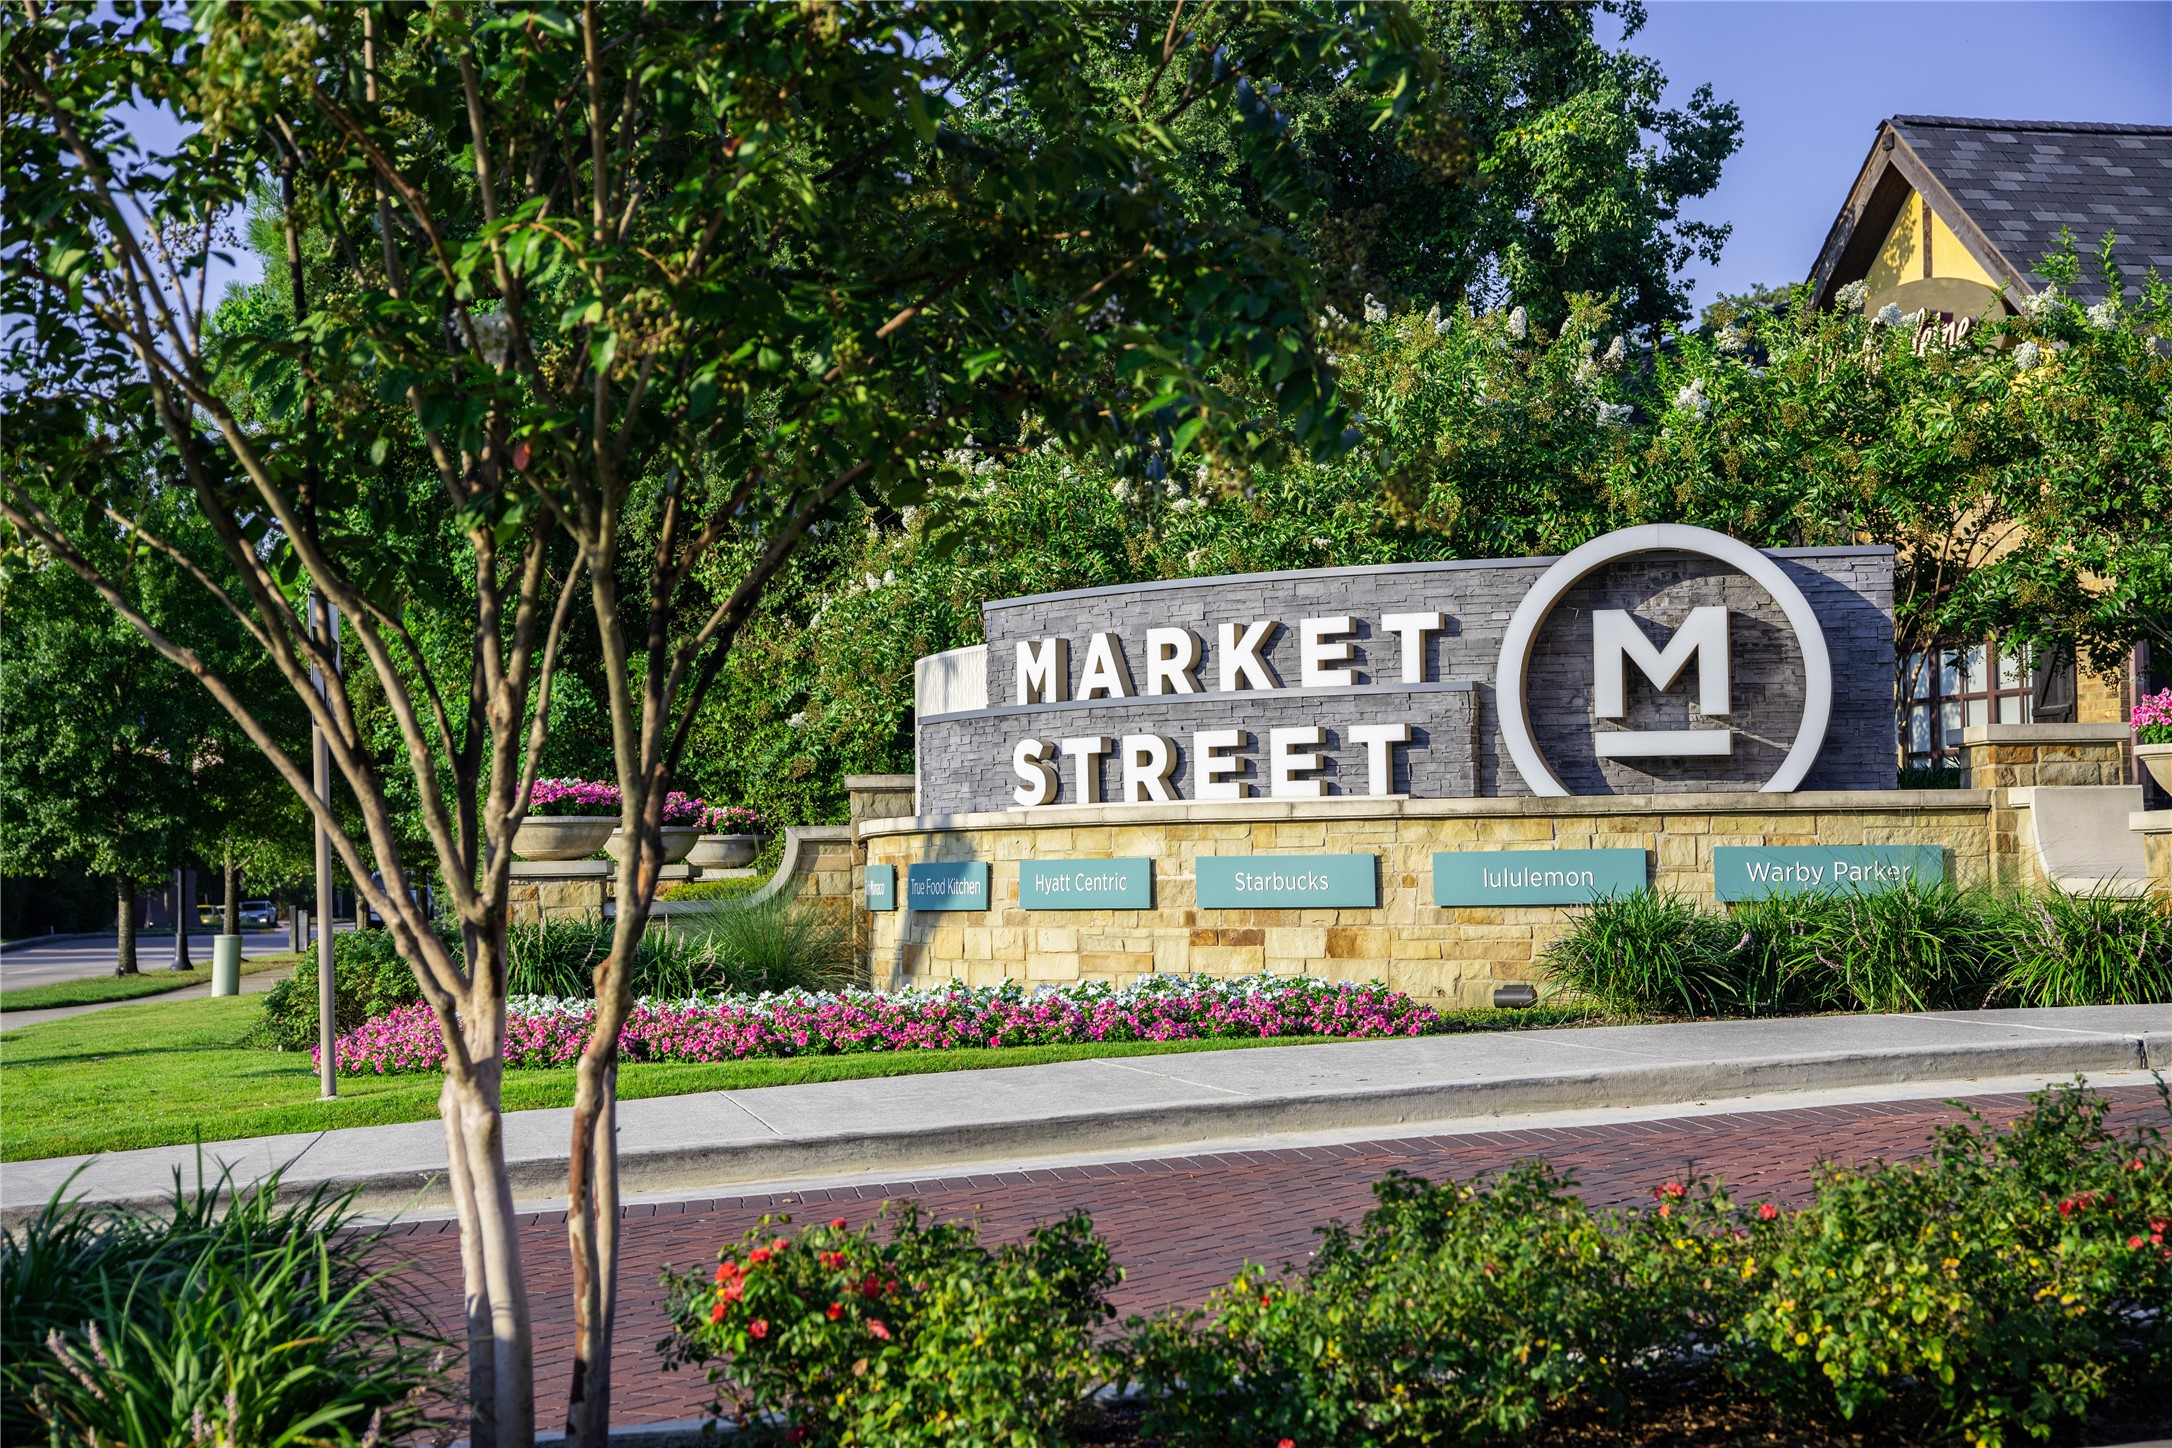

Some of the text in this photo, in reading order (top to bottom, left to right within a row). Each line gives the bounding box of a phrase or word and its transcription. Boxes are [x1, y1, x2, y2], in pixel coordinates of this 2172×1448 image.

[1015, 611, 1446, 706] MARKET
[1012, 722, 1412, 807] STREET
[1035, 872, 1128, 895] Hyatt Centric
[1234, 871, 1329, 892] Starbucks
[1483, 867, 1595, 888] lululemon
[1746, 860, 1912, 885] Warby Parker
[911, 876, 981, 896] True Food Kitchen
